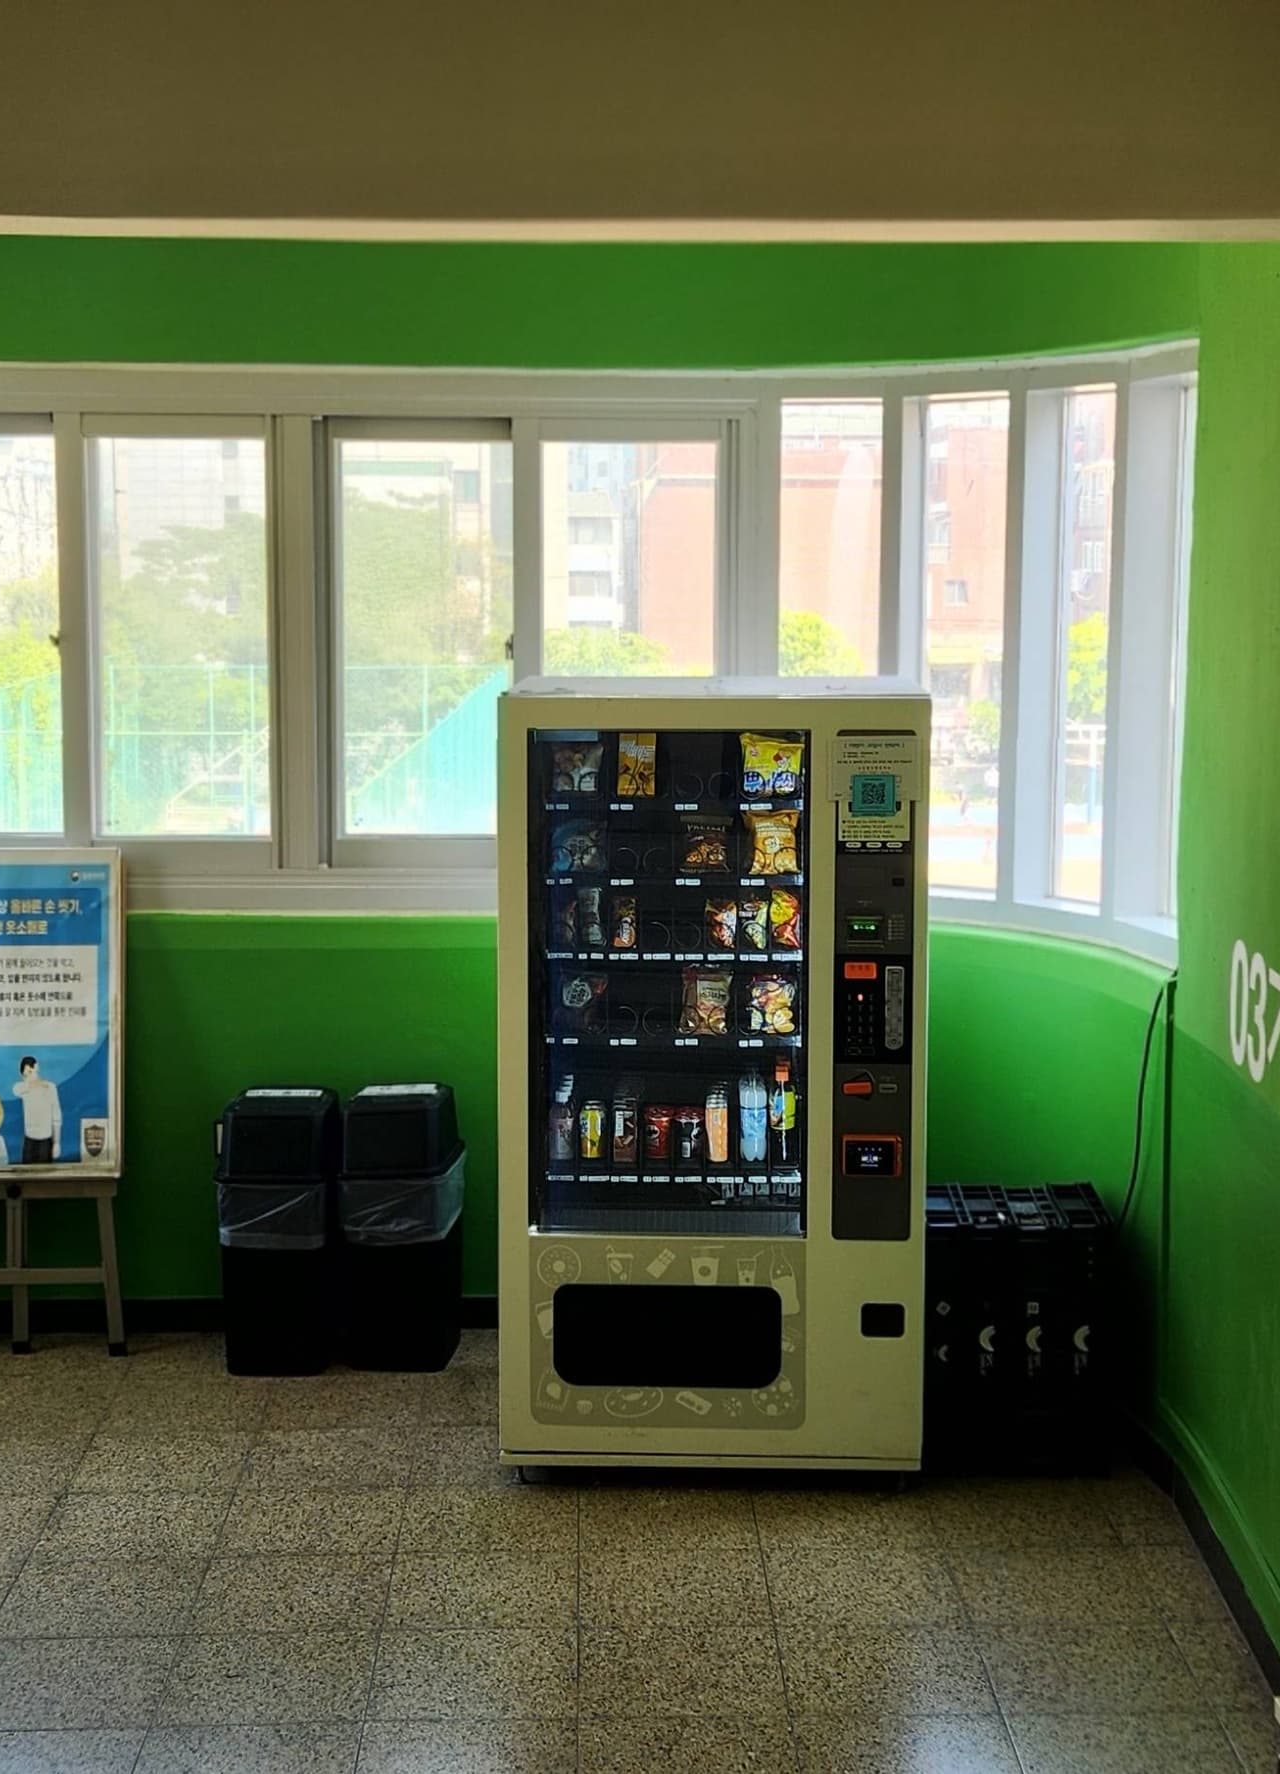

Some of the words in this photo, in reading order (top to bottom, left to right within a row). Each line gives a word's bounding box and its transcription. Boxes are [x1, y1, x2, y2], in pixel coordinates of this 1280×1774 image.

[10, 899, 42, 915] 올바른
[45, 899, 55, 915] 손
[6, 920, 48, 935] 옷소매로
[1230, 939, 1267, 1083] 03
